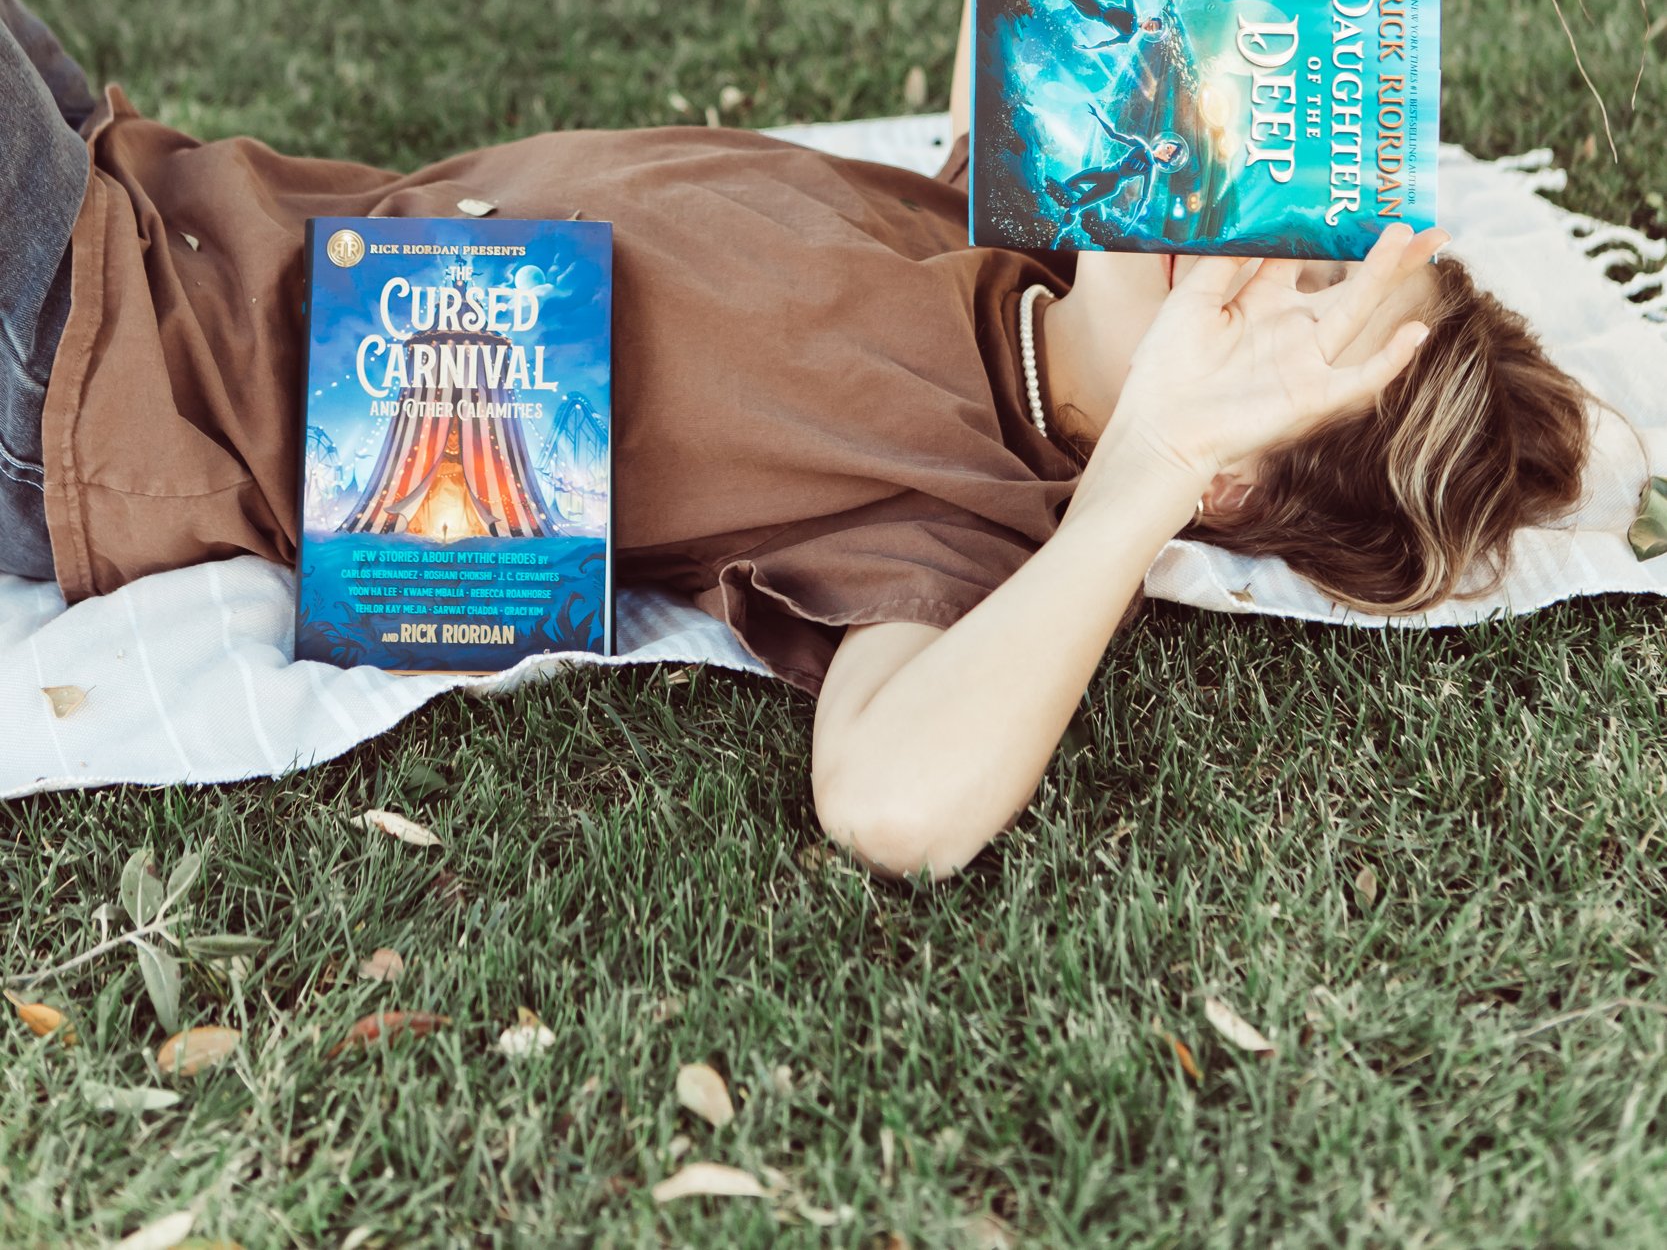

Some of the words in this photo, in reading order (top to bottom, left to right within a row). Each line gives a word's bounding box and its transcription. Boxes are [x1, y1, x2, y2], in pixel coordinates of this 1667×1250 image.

[1410, 25, 1419, 53] YORK
[1307, 56, 1322, 85] OF
[1409, 56, 1418, 84] TIMES
[1236, 13, 1299, 183] DEEP
[1409, 86, 1417, 97] #1
[1306, 94, 1322, 138] THE
[1408, 99, 1418, 163] BEST-SELLING
[1376, 74, 1406, 218] RIORDAN
[1407, 165, 1416, 206] AUTHOR
[370, 244, 399, 255] RICK
[402, 245, 459, 255] RIORDAN
[462, 246, 526, 256] PRESENTS
[449, 266, 473, 281] THE
[379, 276, 540, 341] CURSED
[356, 334, 559, 398] CARNIVAL
[370, 403, 399, 417] AND
[402, 398, 454, 419] OTHER
[456, 399, 544, 421] CALAMITIES
[352, 550, 377, 562] NEW
[379, 550, 419, 563] STORIES
[421, 551, 455, 564] ABOUT
[457, 552, 496, 564] MYTHIC
[498, 553, 536, 565] HEROES
[538, 556, 549, 565] BY
[341, 569, 371, 579] CARLOS
[372, 570, 418, 580] HERNANDEZ
[423, 570, 458, 581] ROSHANI
[459, 571, 493, 581] CHOKSHI
[515, 572, 560, 582] CERVANTES
[348, 586, 370, 596] YOON
[371, 586, 382, 596] HA
[383, 587, 398, 597] LEE
[403, 587, 433, 597] KWAME
[470, 588, 505, 599] REBECCA
[505, 589, 552, 599] ROANHORSE
[355, 603, 384, 614] TEHLOR
[385, 604, 401, 614] KAY
[402, 604, 427, 615] MEJIA
[432, 605, 466, 615] SARWAT
[466, 605, 499, 615] CHADDA
[504, 606, 528, 616] GRACI
[528, 607, 544, 616] KIM
[381, 633, 399, 643] AND
[400, 623, 438, 644] RICK
[441, 624, 515, 645] RIORDAN
